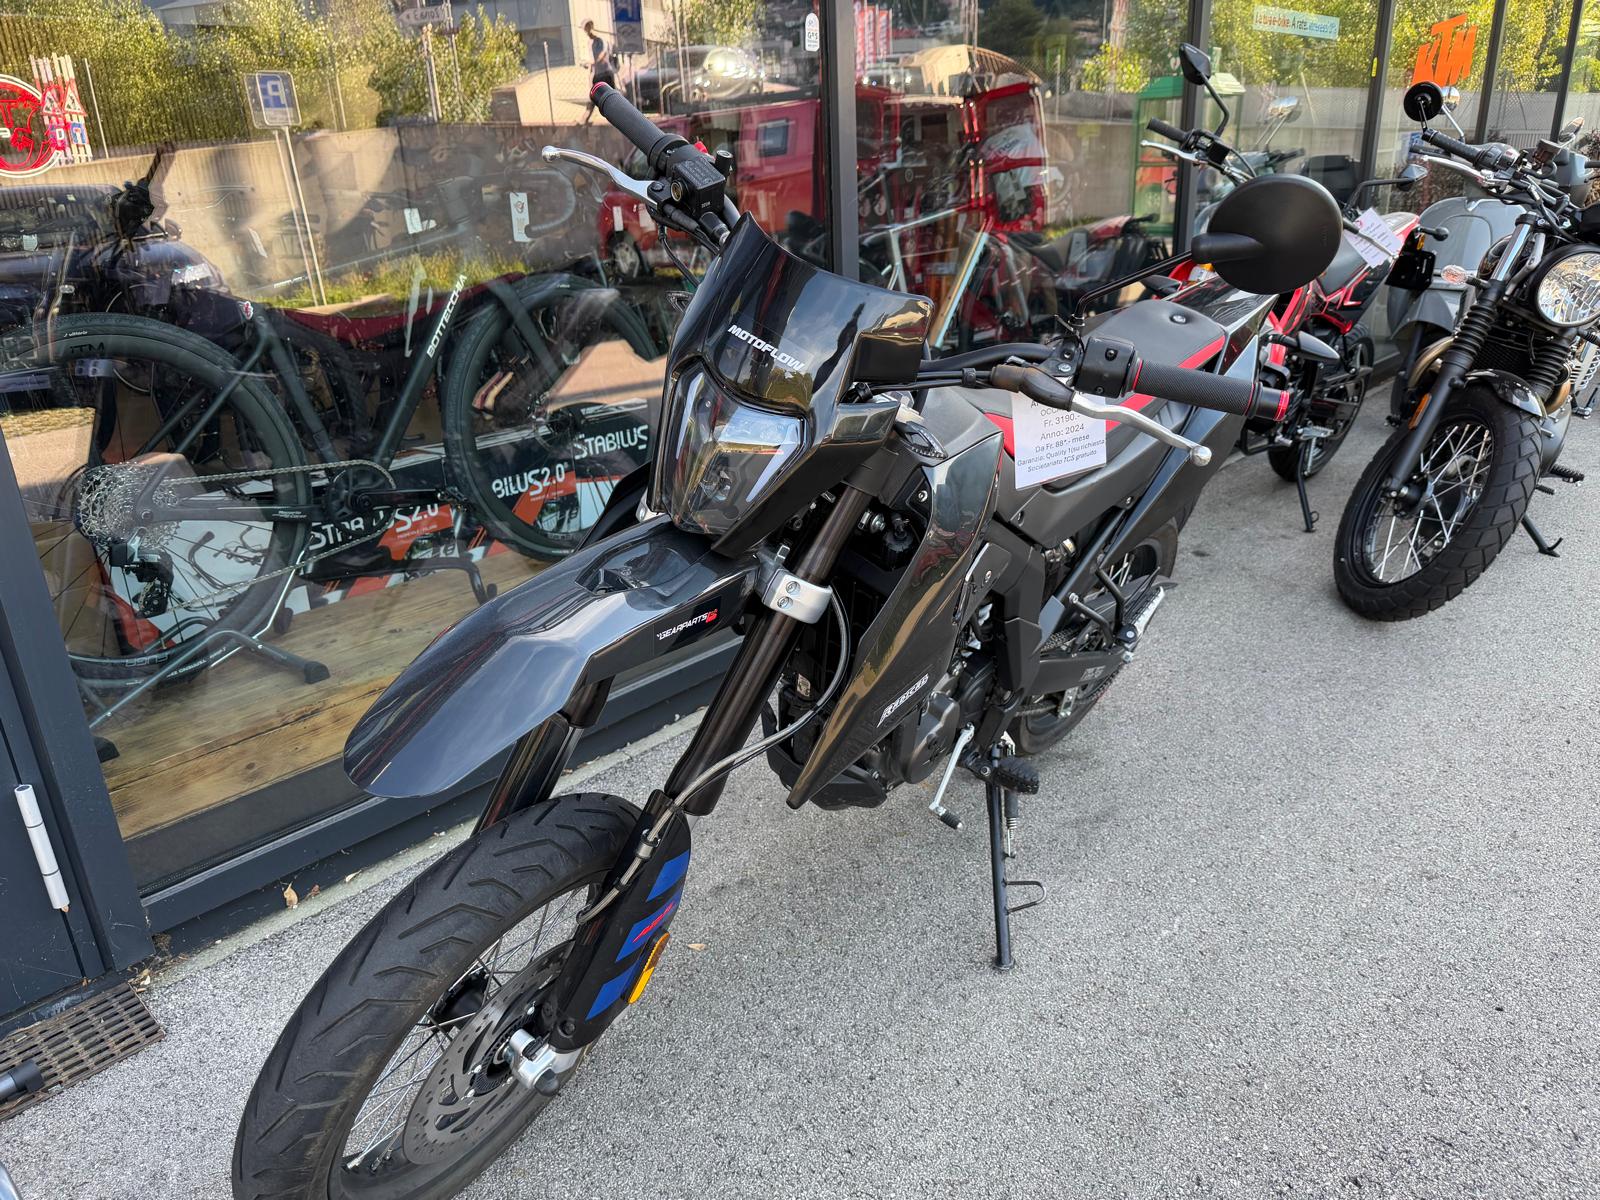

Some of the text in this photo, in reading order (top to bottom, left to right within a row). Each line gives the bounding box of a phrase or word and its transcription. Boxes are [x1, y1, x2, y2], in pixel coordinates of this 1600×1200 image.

[1410, 11, 1478, 88] KTM
[426, 274, 468, 359] BOTTECCHIA
[727, 324, 805, 371] MOTOFLOW
[1040, 424, 1085, 441] Anno: 2024
[1044, 414, 1080, 428] Fr. 3190.-
[574, 424, 649, 460] STABILUS
[1035, 445, 1045, 453] Da
[1046, 443, 1055, 451] Fr.
[1072, 434, 1090, 443] mese
[1046, 450, 1067, 460] Quality
